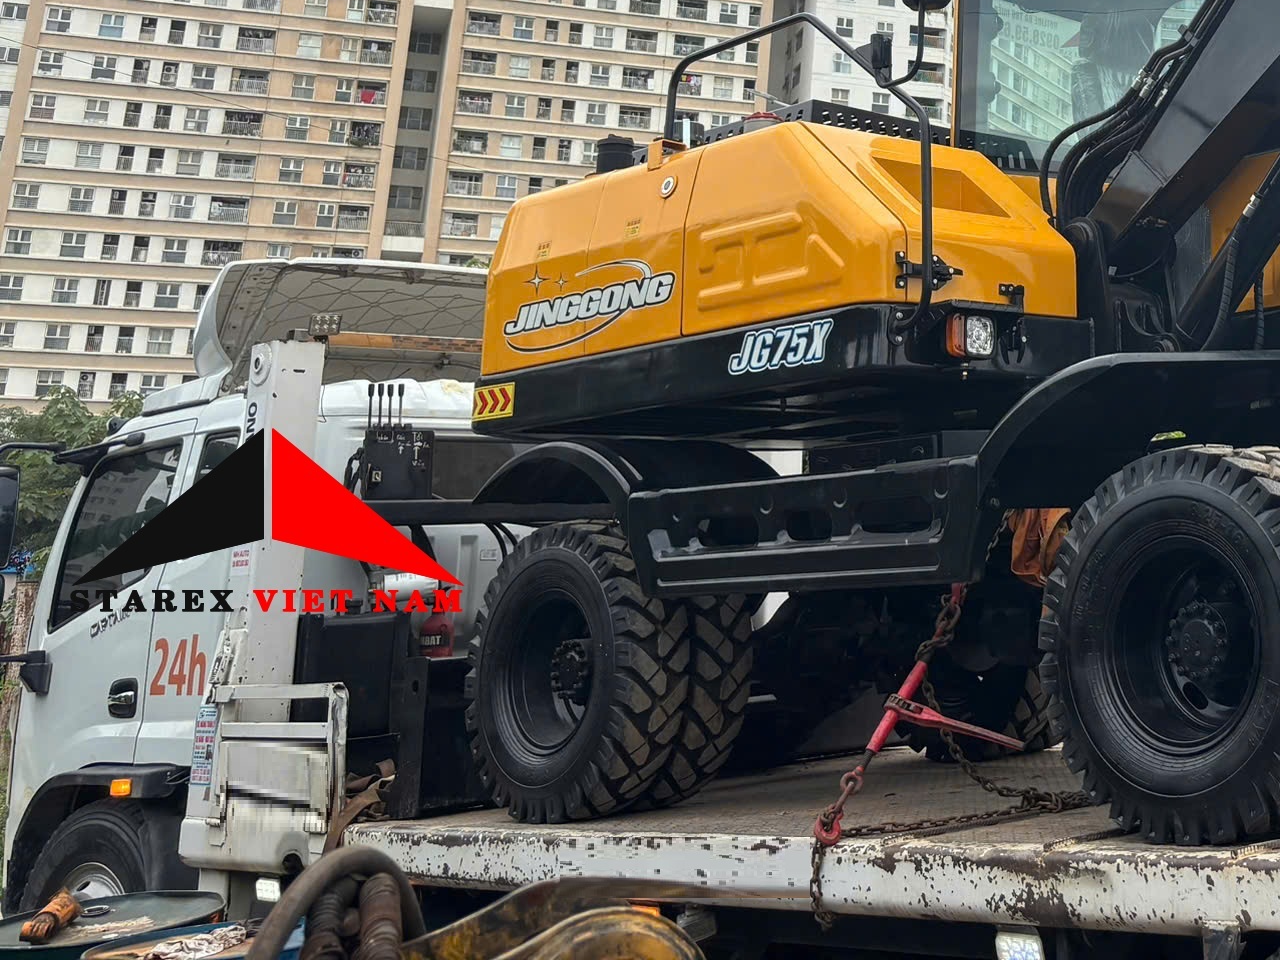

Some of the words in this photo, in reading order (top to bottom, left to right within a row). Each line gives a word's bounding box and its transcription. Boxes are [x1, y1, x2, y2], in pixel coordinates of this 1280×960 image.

[504, 273, 675, 335] JINGGONG
[729, 320, 833, 374] JG75X
[150, 634, 207, 696] 24h
